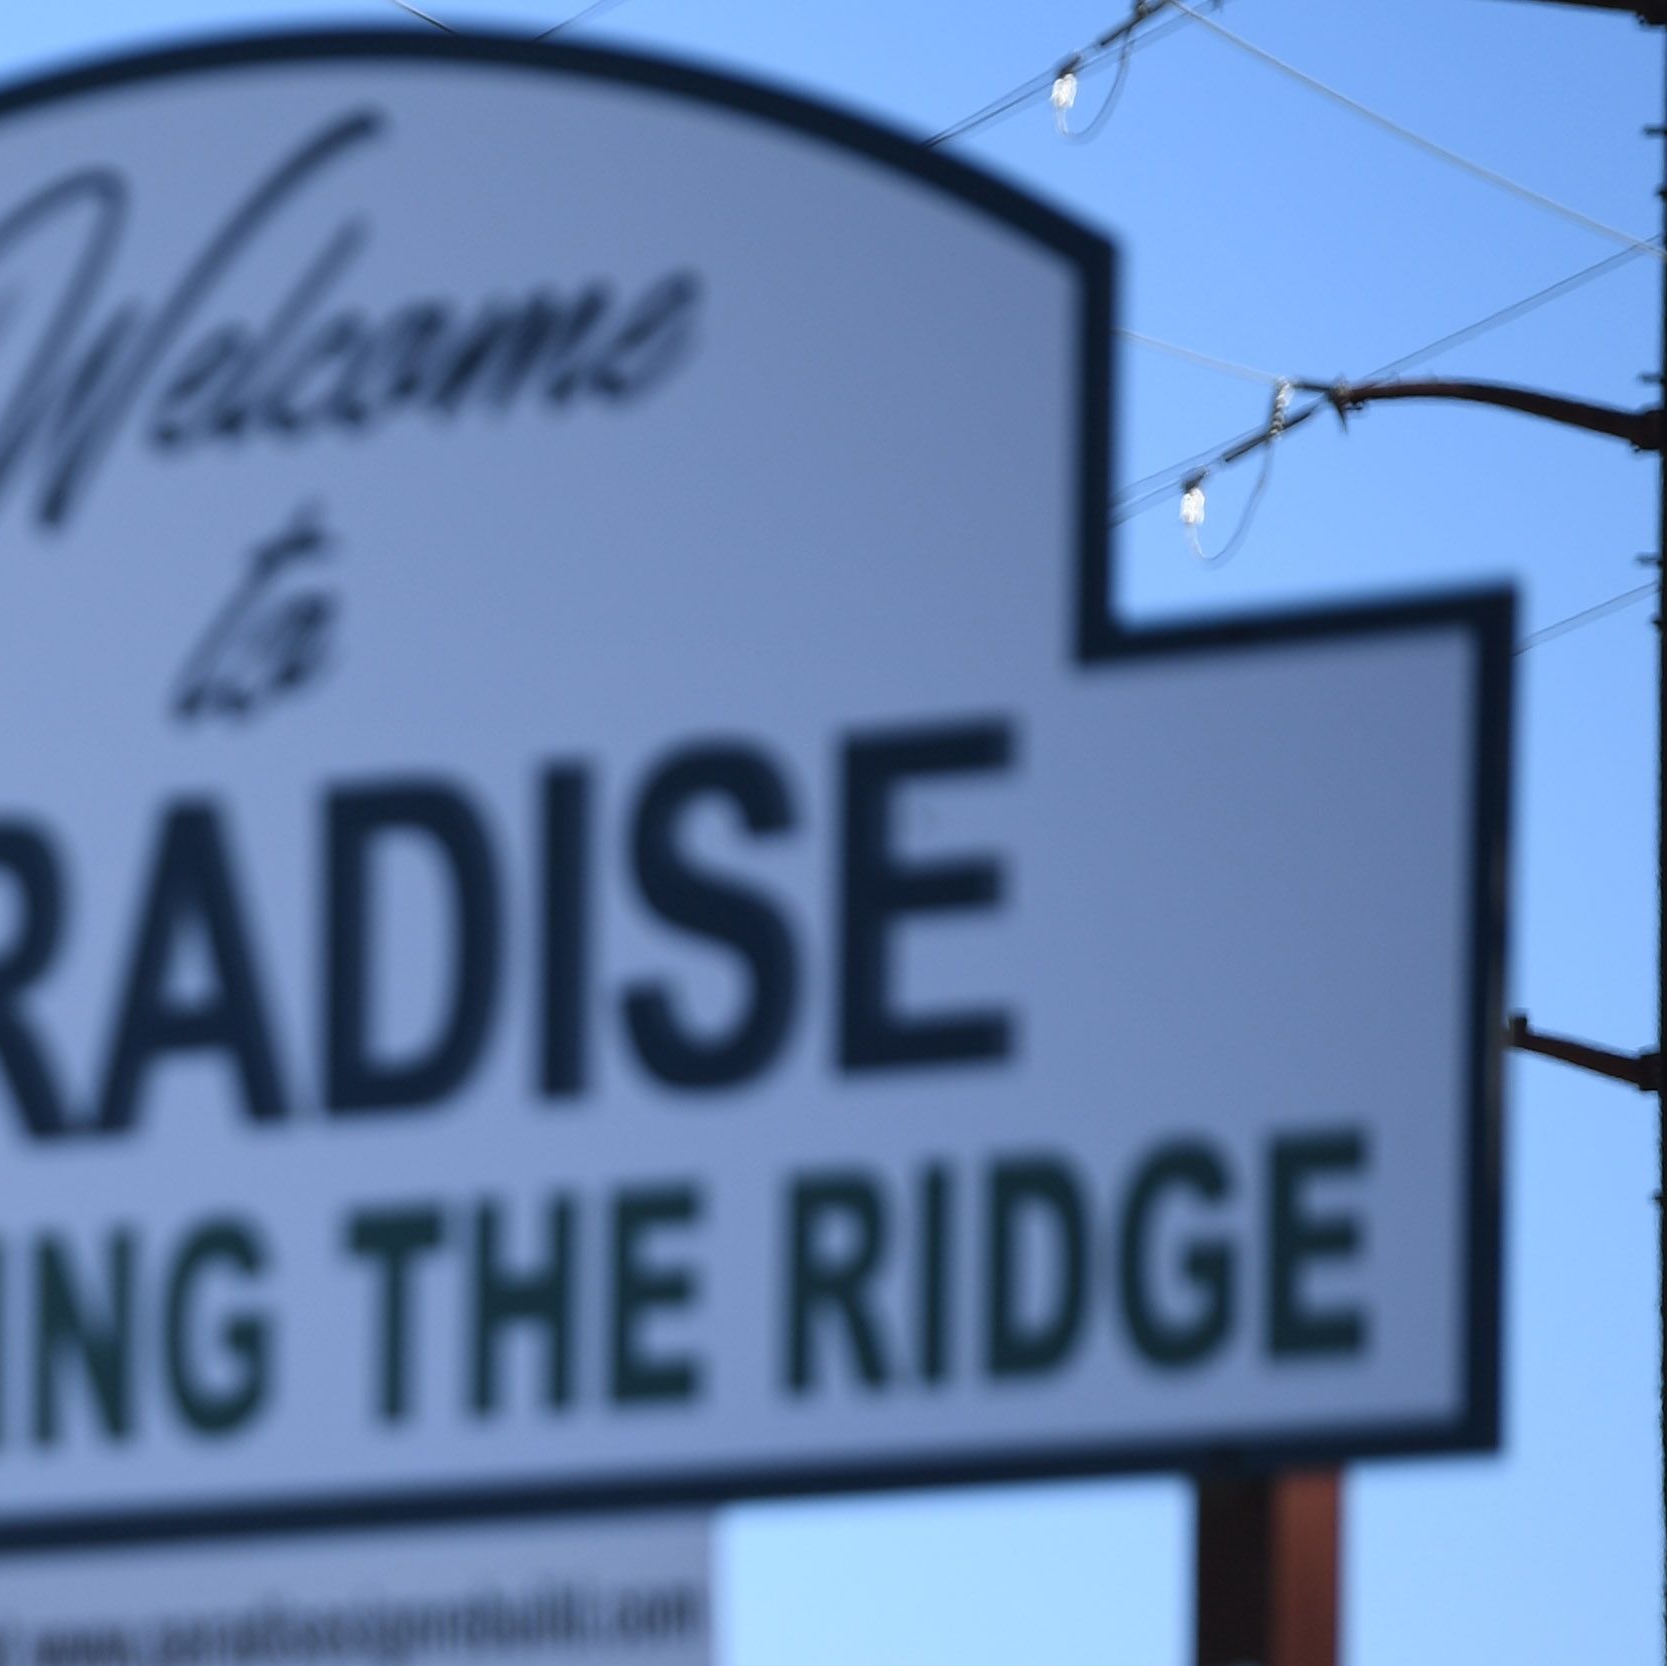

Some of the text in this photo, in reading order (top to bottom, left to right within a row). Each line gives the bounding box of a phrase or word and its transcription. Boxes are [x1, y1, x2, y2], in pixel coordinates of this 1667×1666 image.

[170, 504, 343, 727] to
[343, 1178, 704, 1426] THE
[779, 1121, 1375, 1402] RIDGE
